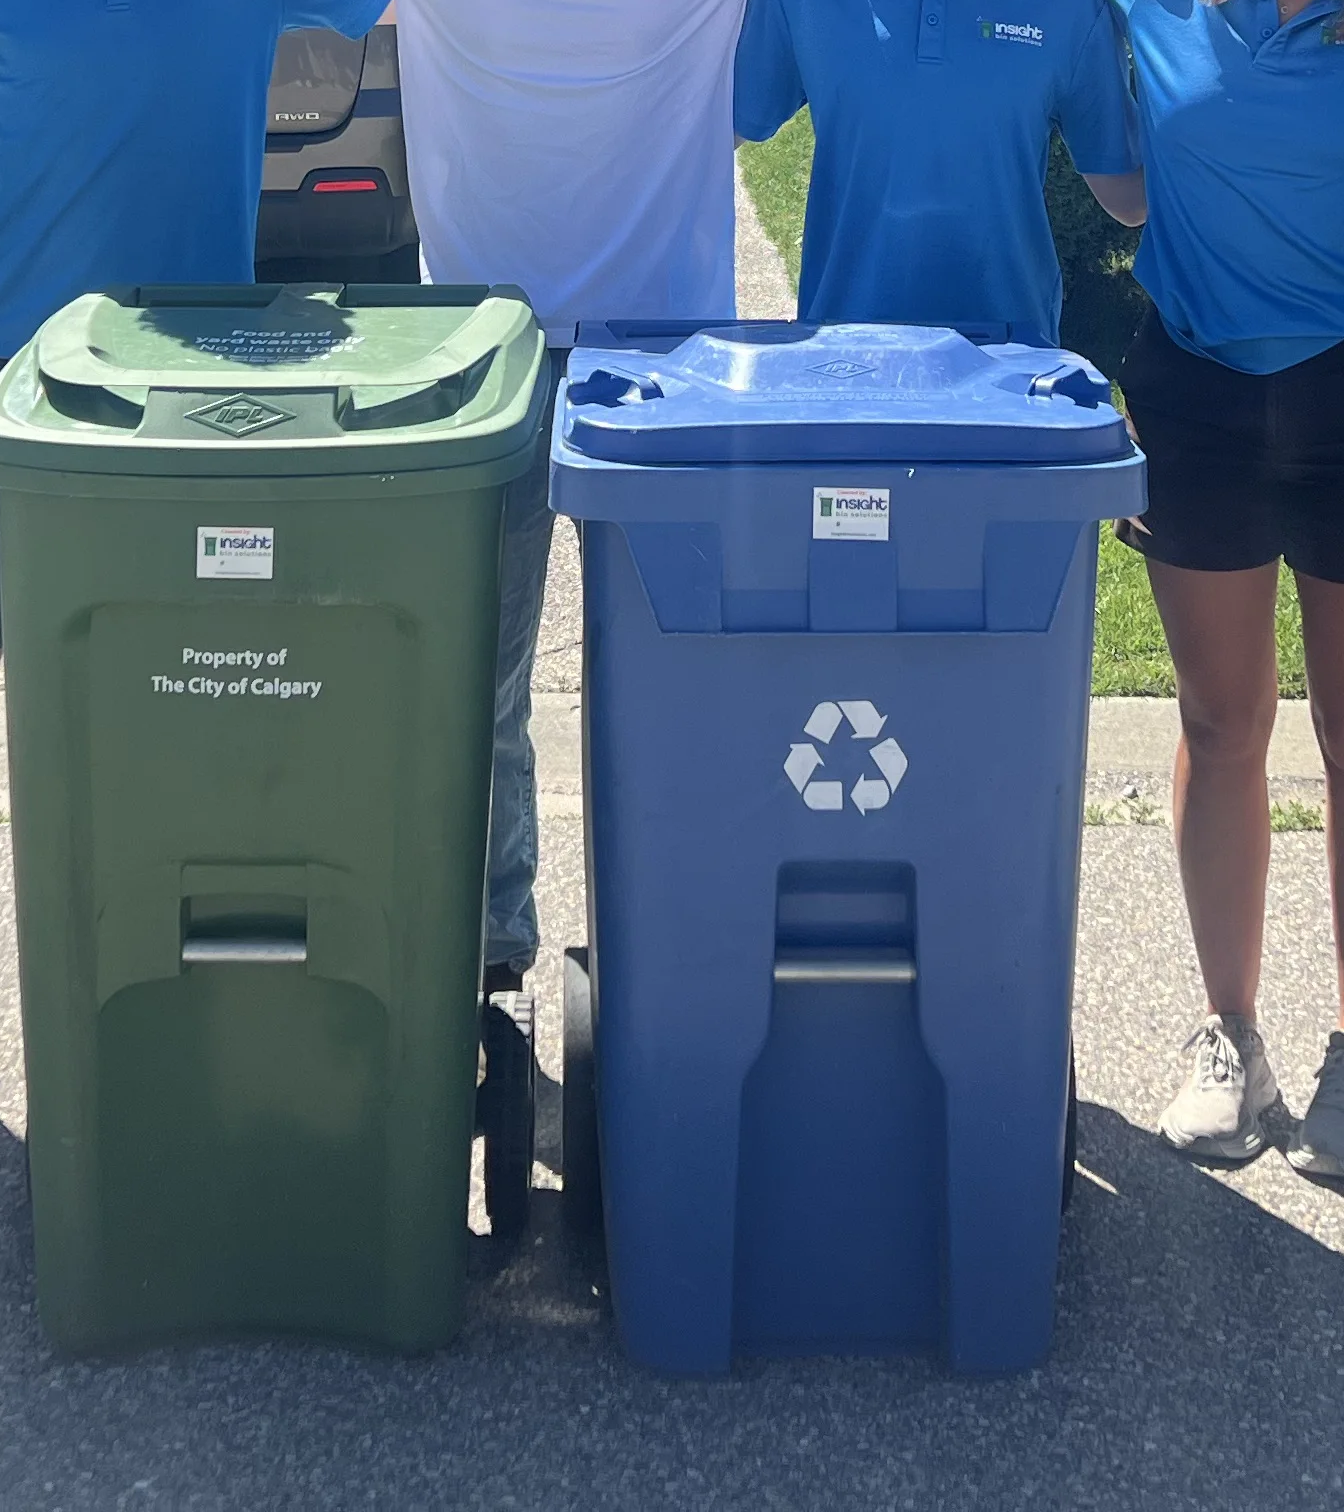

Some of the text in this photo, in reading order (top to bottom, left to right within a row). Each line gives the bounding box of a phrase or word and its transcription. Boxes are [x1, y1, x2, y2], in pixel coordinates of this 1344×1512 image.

[994, 23, 1044, 40] insight
[275, 112, 320, 121] AWD
[194, 336, 246, 345] yard
[231, 329, 286, 337] Food
[199, 343, 230, 352] No
[233, 345, 301, 354] plastic
[214, 405, 264, 424] IPL
[836, 495, 888, 511] insight
[220, 534, 272, 549] insight
[182, 647, 288, 670] Property of
[150, 675, 322, 699] The City of Calgary
